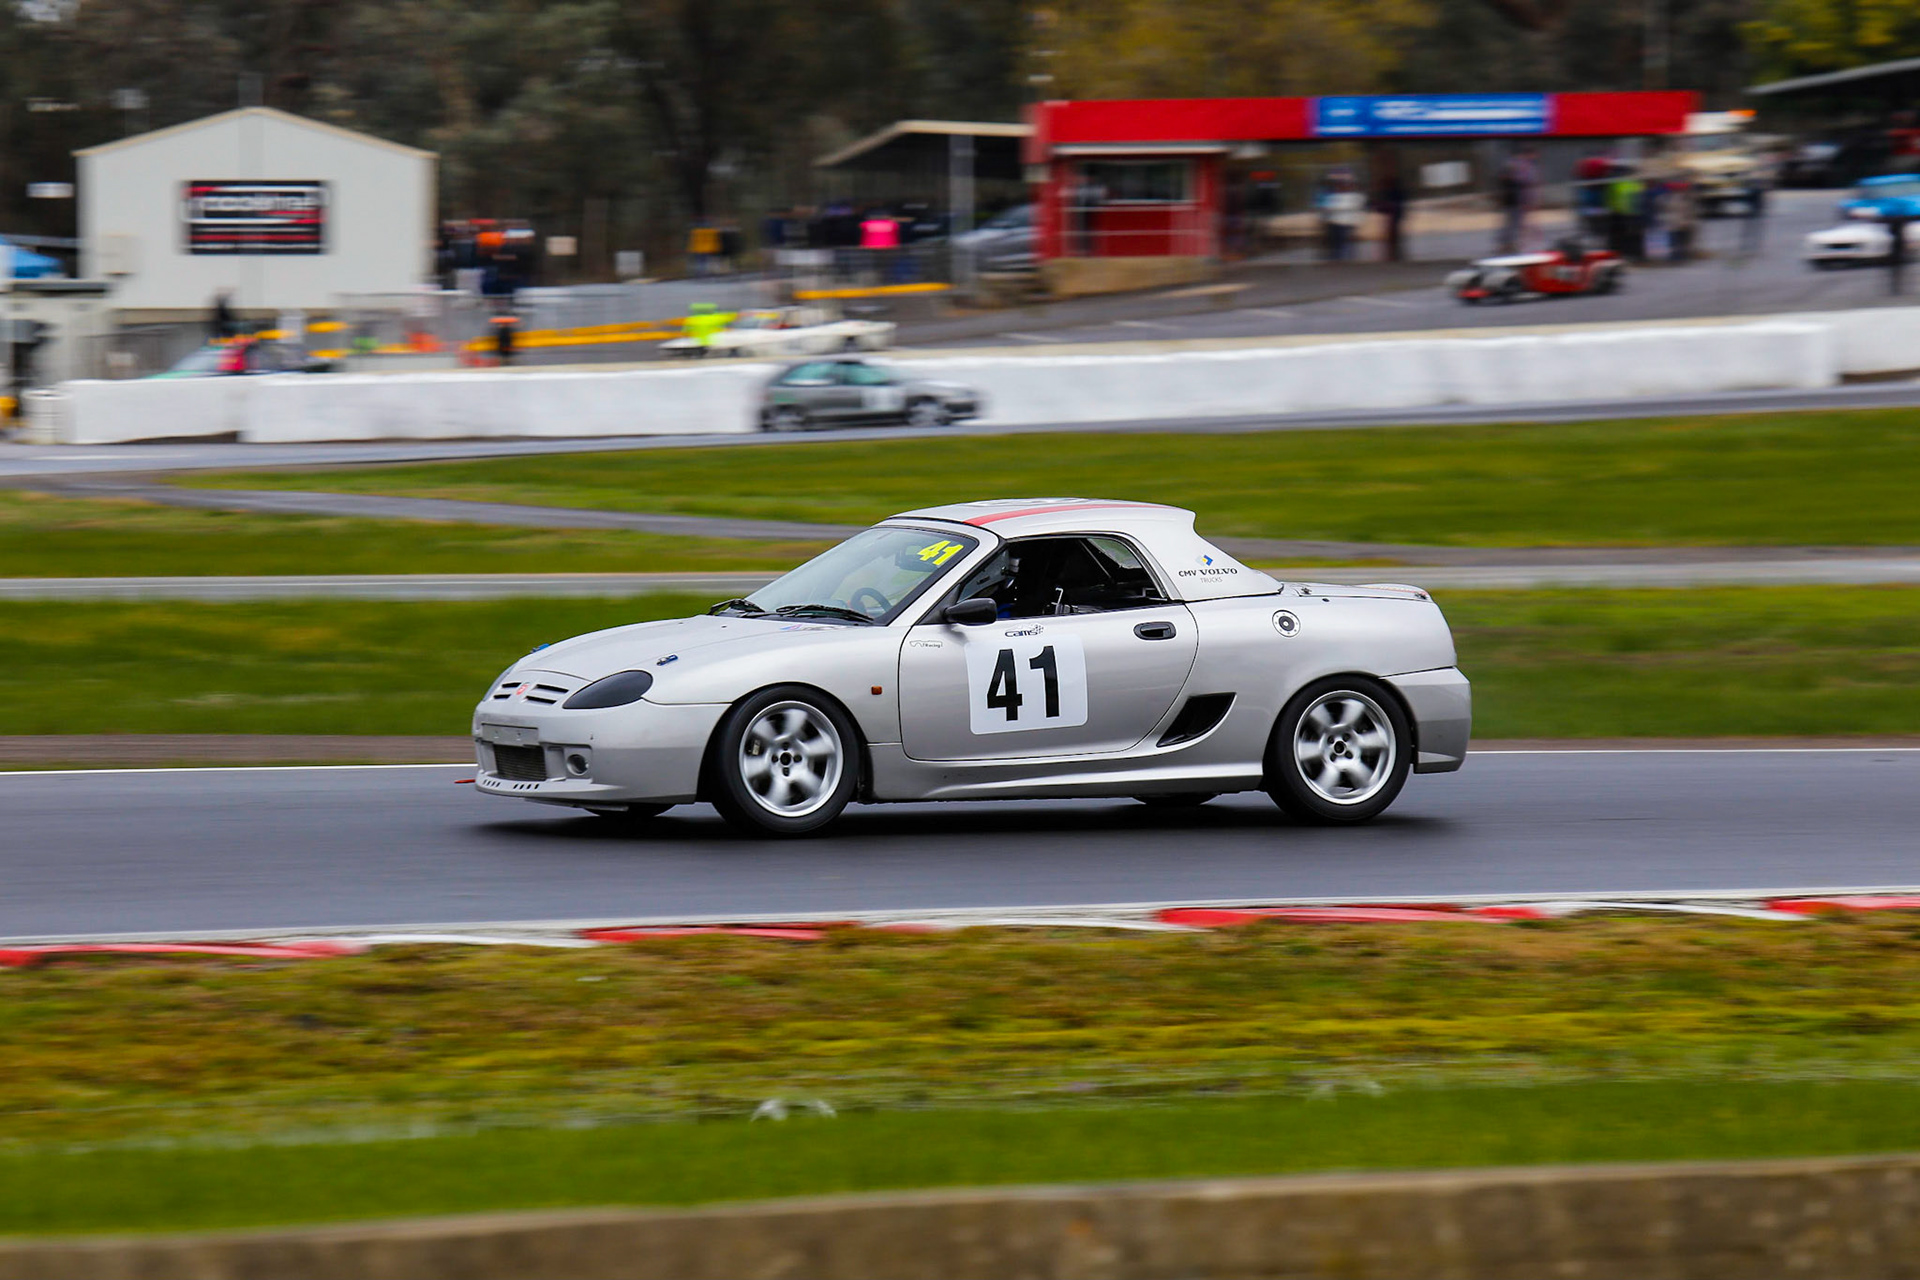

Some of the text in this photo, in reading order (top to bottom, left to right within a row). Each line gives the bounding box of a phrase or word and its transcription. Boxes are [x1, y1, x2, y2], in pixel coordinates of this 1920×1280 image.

[917, 540, 964, 565] 41
[1199, 568, 1238, 576] VOLVO
[987, 645, 1060, 721] 41
